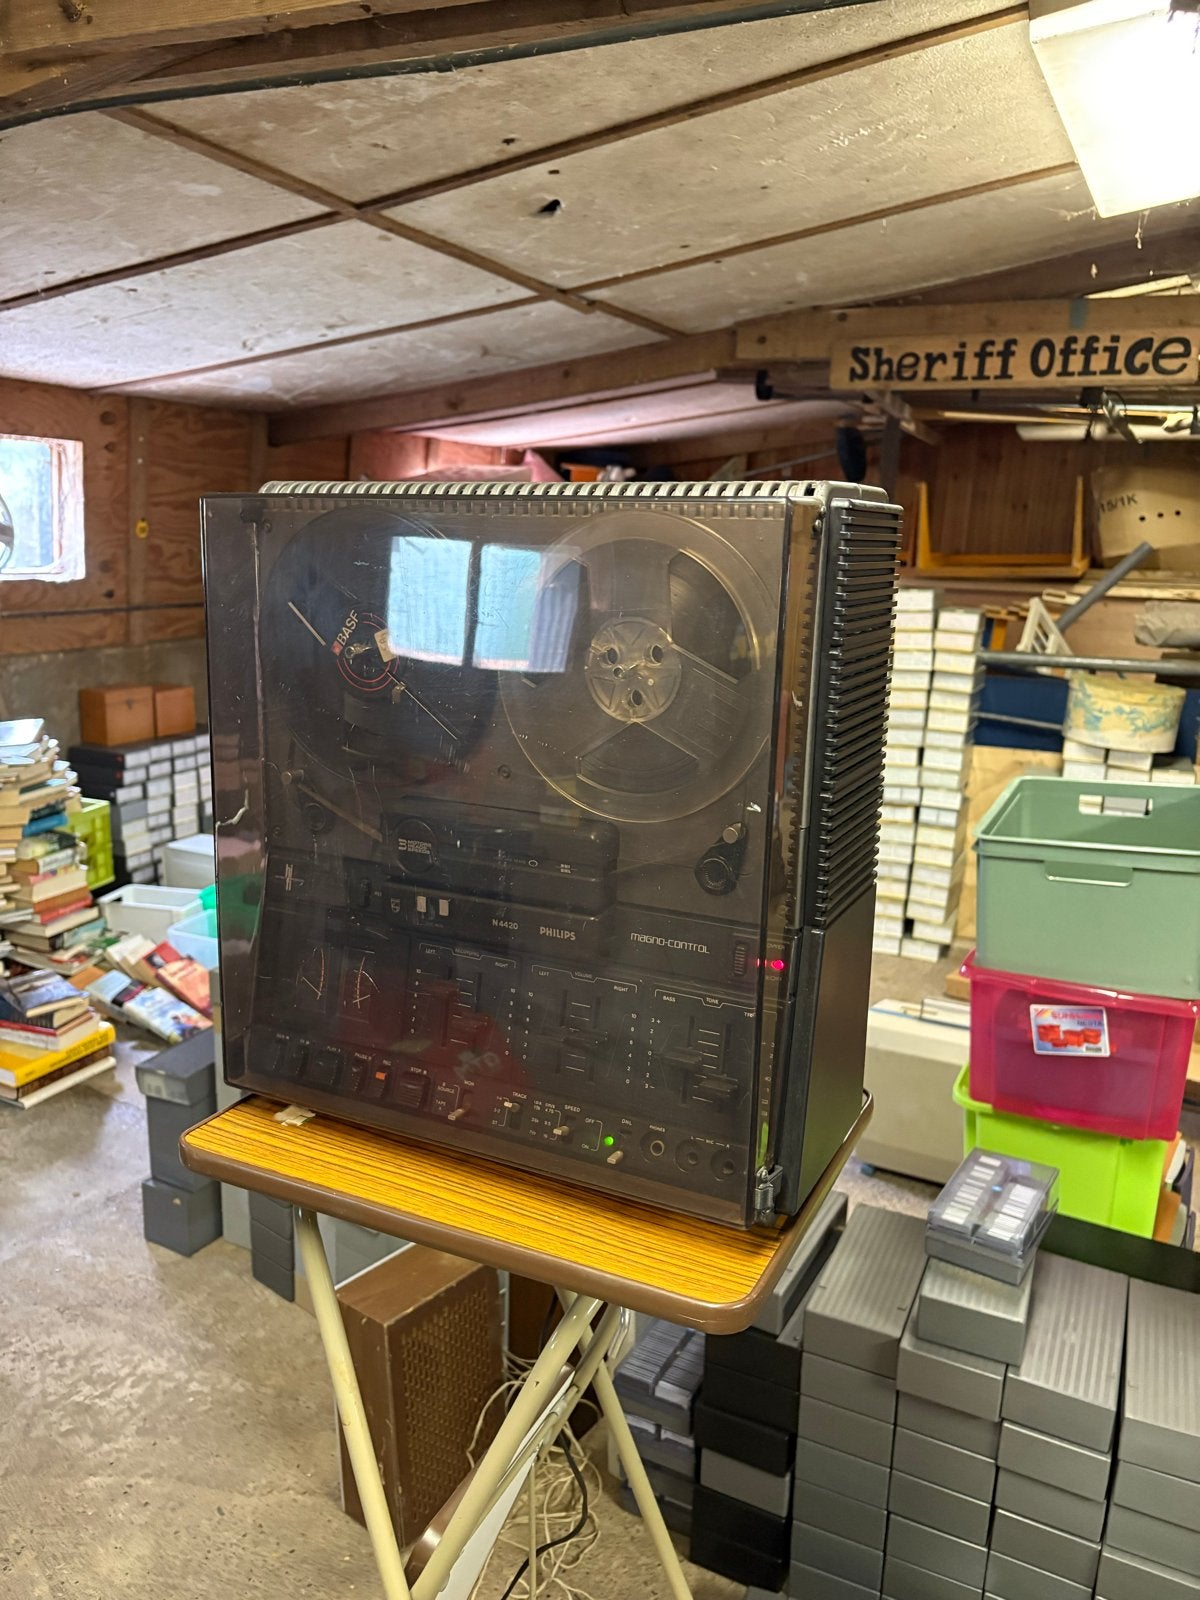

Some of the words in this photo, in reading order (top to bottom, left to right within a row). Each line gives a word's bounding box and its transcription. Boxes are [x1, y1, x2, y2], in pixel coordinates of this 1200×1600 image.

[849, 338, 1018, 382] Sheriff
[1030, 335, 1192, 378] Office
[336, 609, 358, 646] BASF
[539, 926, 576, 941] PHILIPS
[512, 1092, 528, 1100] TRACK
[564, 1104, 581, 1113] SPEED
[621, 1118, 633, 1126] DNL
